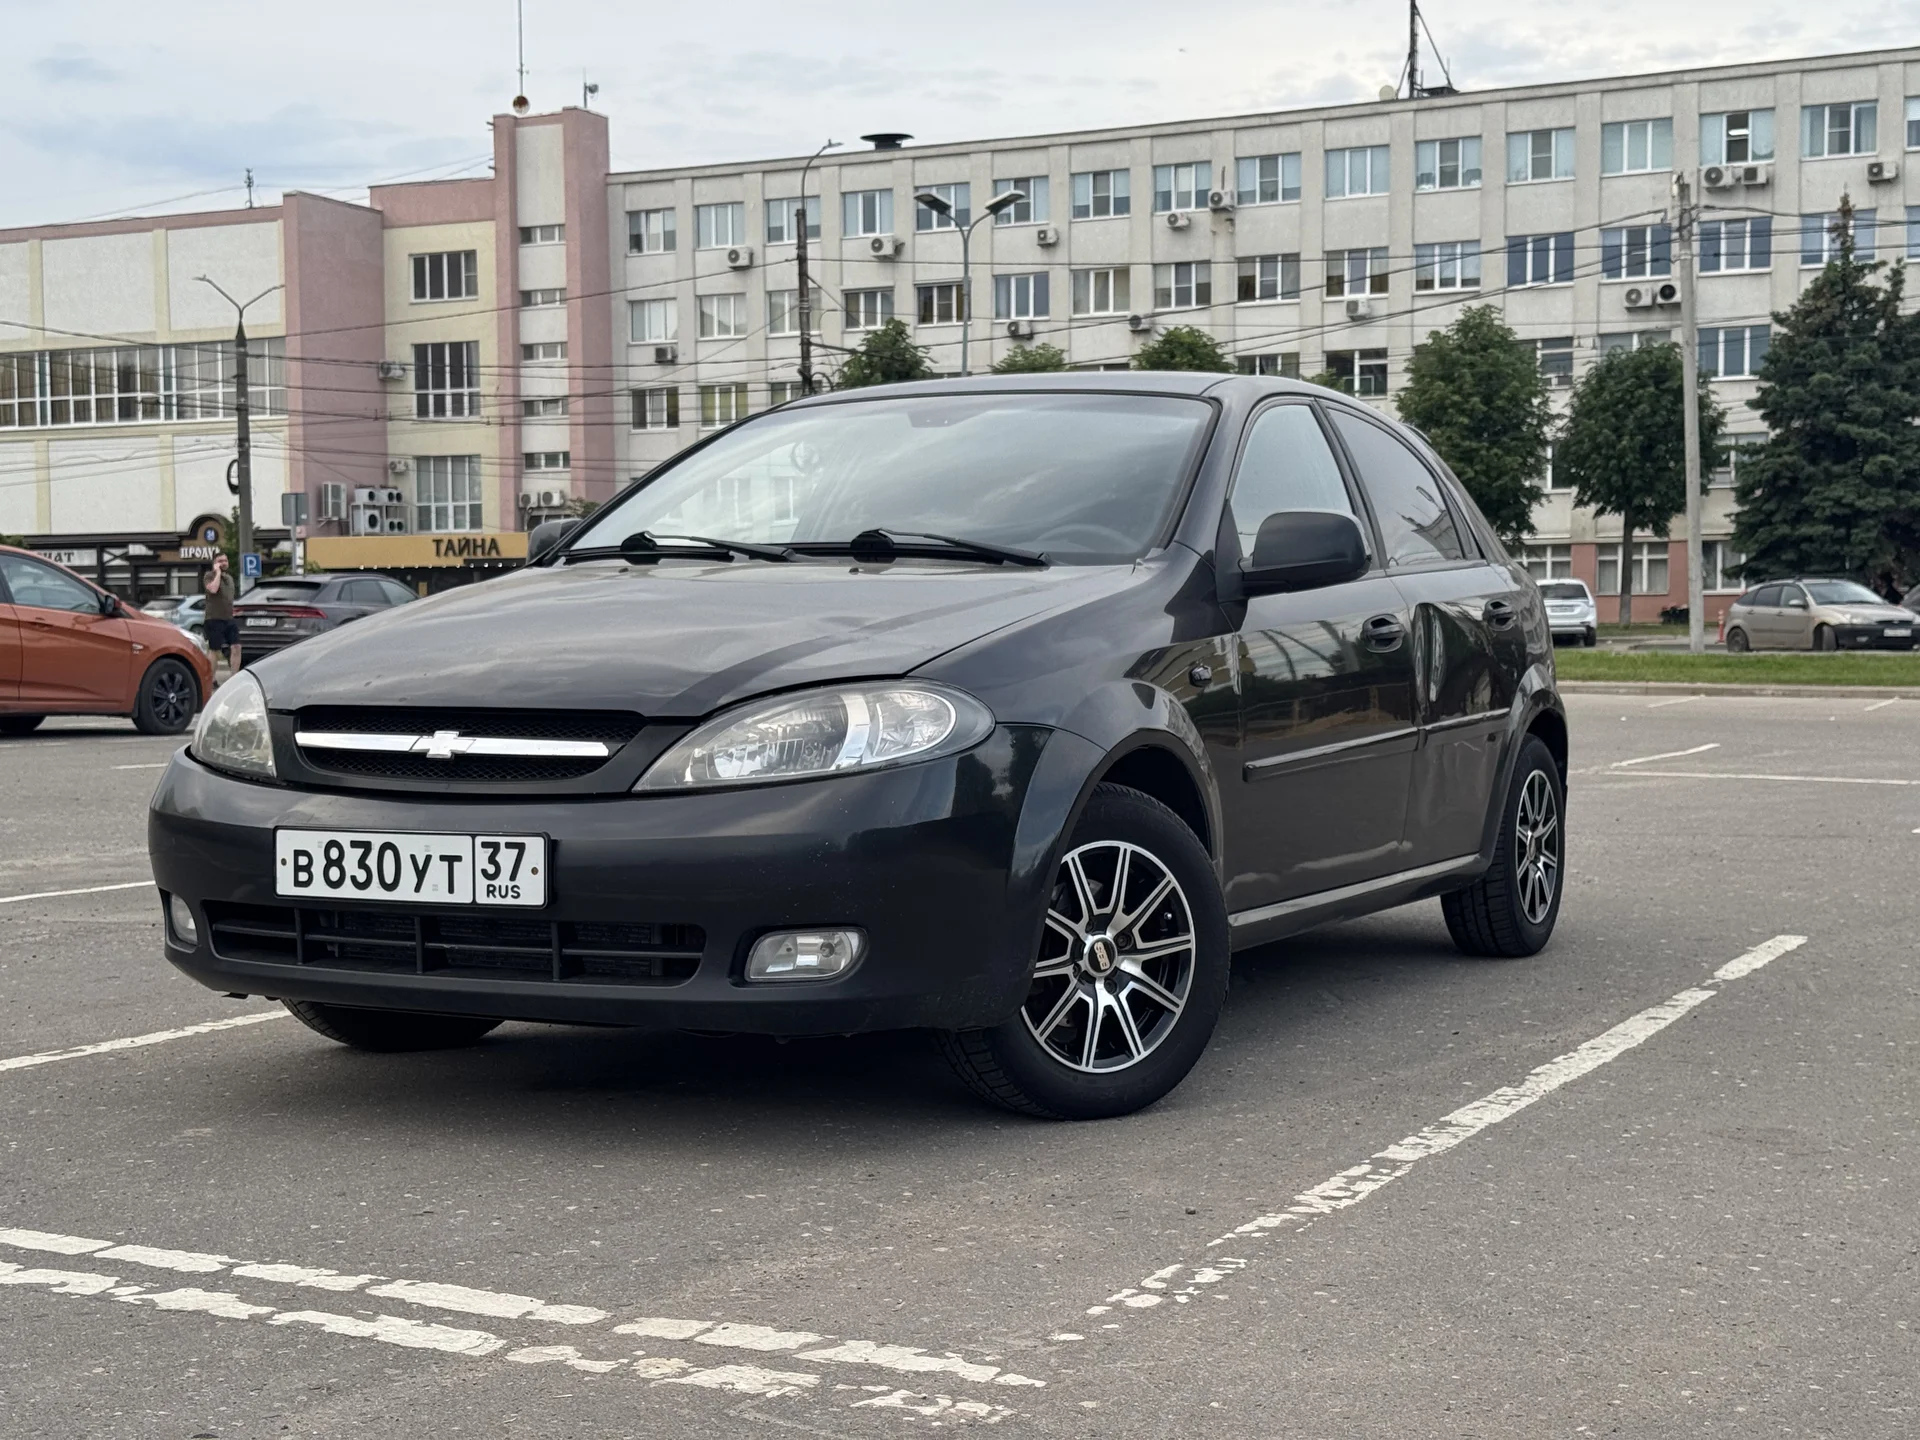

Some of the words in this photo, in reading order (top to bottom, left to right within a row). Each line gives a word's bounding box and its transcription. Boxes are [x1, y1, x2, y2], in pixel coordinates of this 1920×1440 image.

[432, 537, 501, 557] ТАЙНА
[293, 839, 463, 894] В830УТ
[480, 841, 526, 882] 37
[486, 884, 521, 899] RUS
